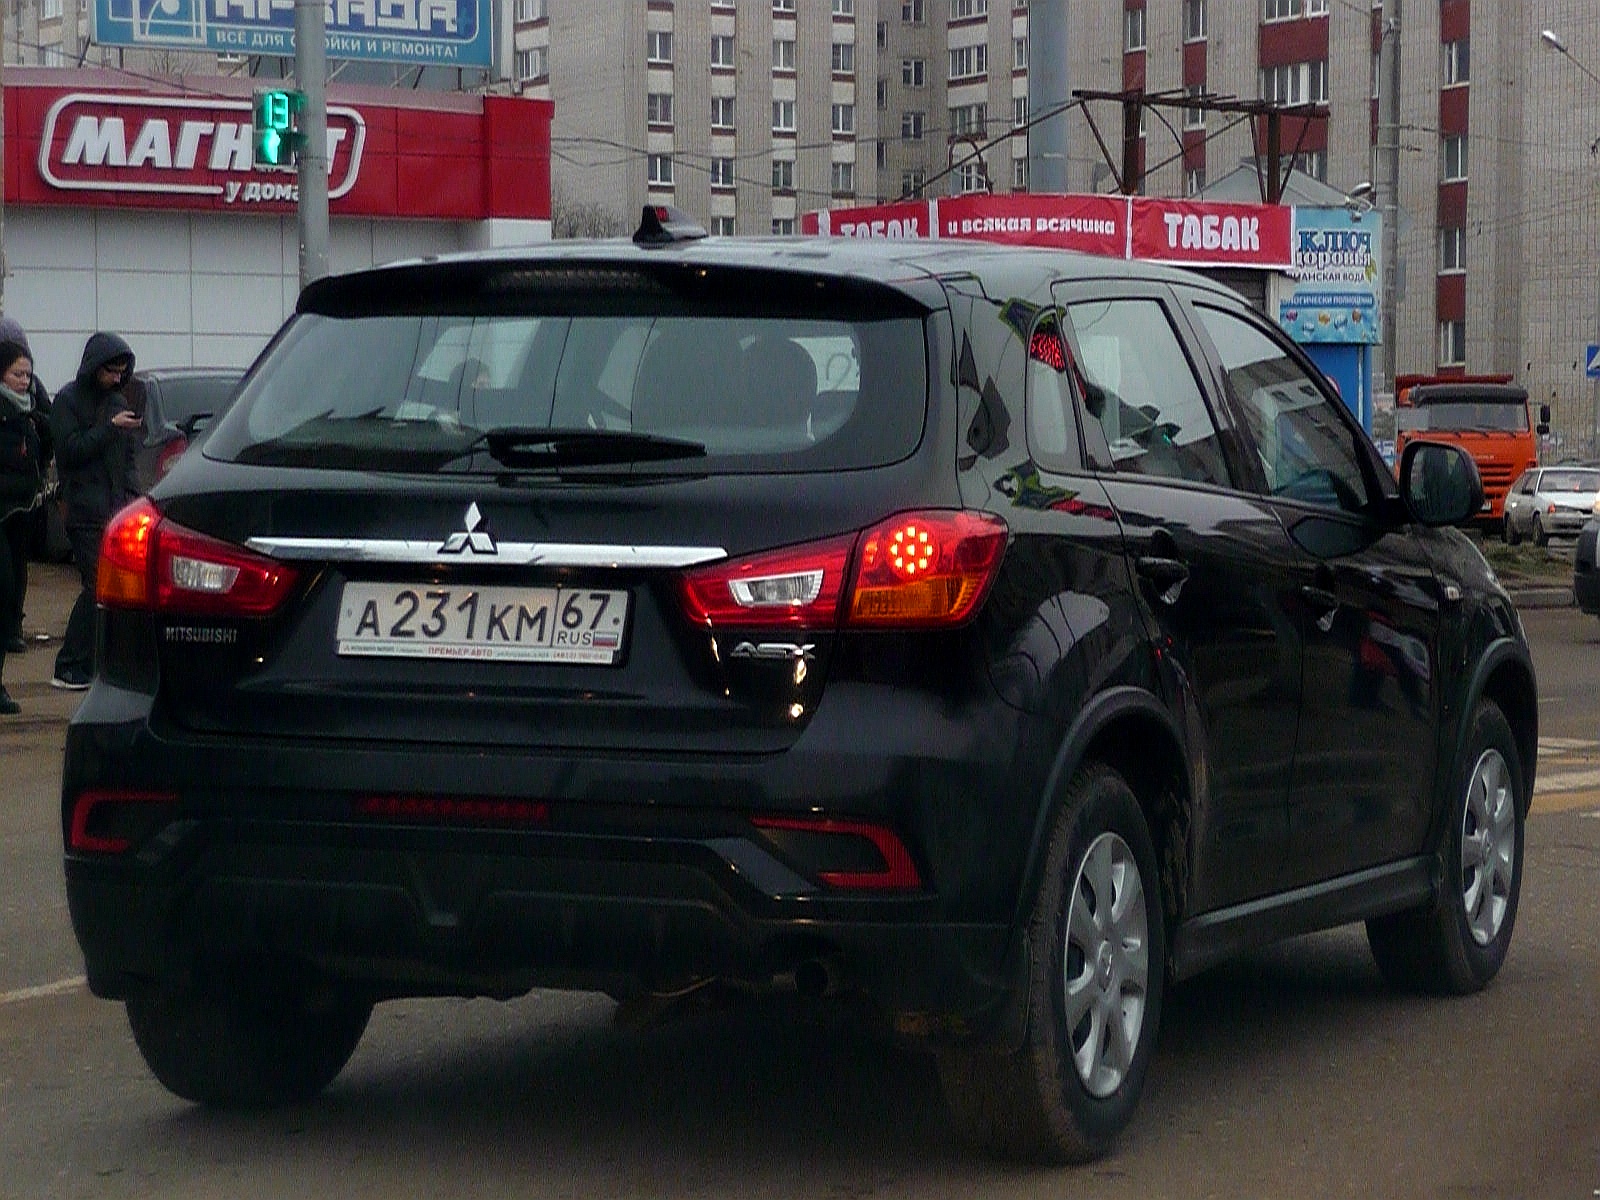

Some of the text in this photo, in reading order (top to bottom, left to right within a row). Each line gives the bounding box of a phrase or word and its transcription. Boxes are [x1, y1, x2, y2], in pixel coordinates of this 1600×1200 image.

[216, 0, 457, 33] АРАДА
[252, 32, 284, 48] ДЛЯ
[291, 33, 360, 52] СОЙКИ
[367, 41, 377, 53] И
[383, 41, 458, 58] РЕМОНТА!
[61, 114, 346, 175] МАГНТ
[1163, 213, 1260, 251] ТАБАК
[1298, 230, 1372, 253] КЛЮЧ
[1296, 251, 1371, 270] доровья
[355, 590, 611, 642] А231КМ 67
[165, 626, 237, 643] MITSUBISHI
[557, 631, 592, 646] RUS
